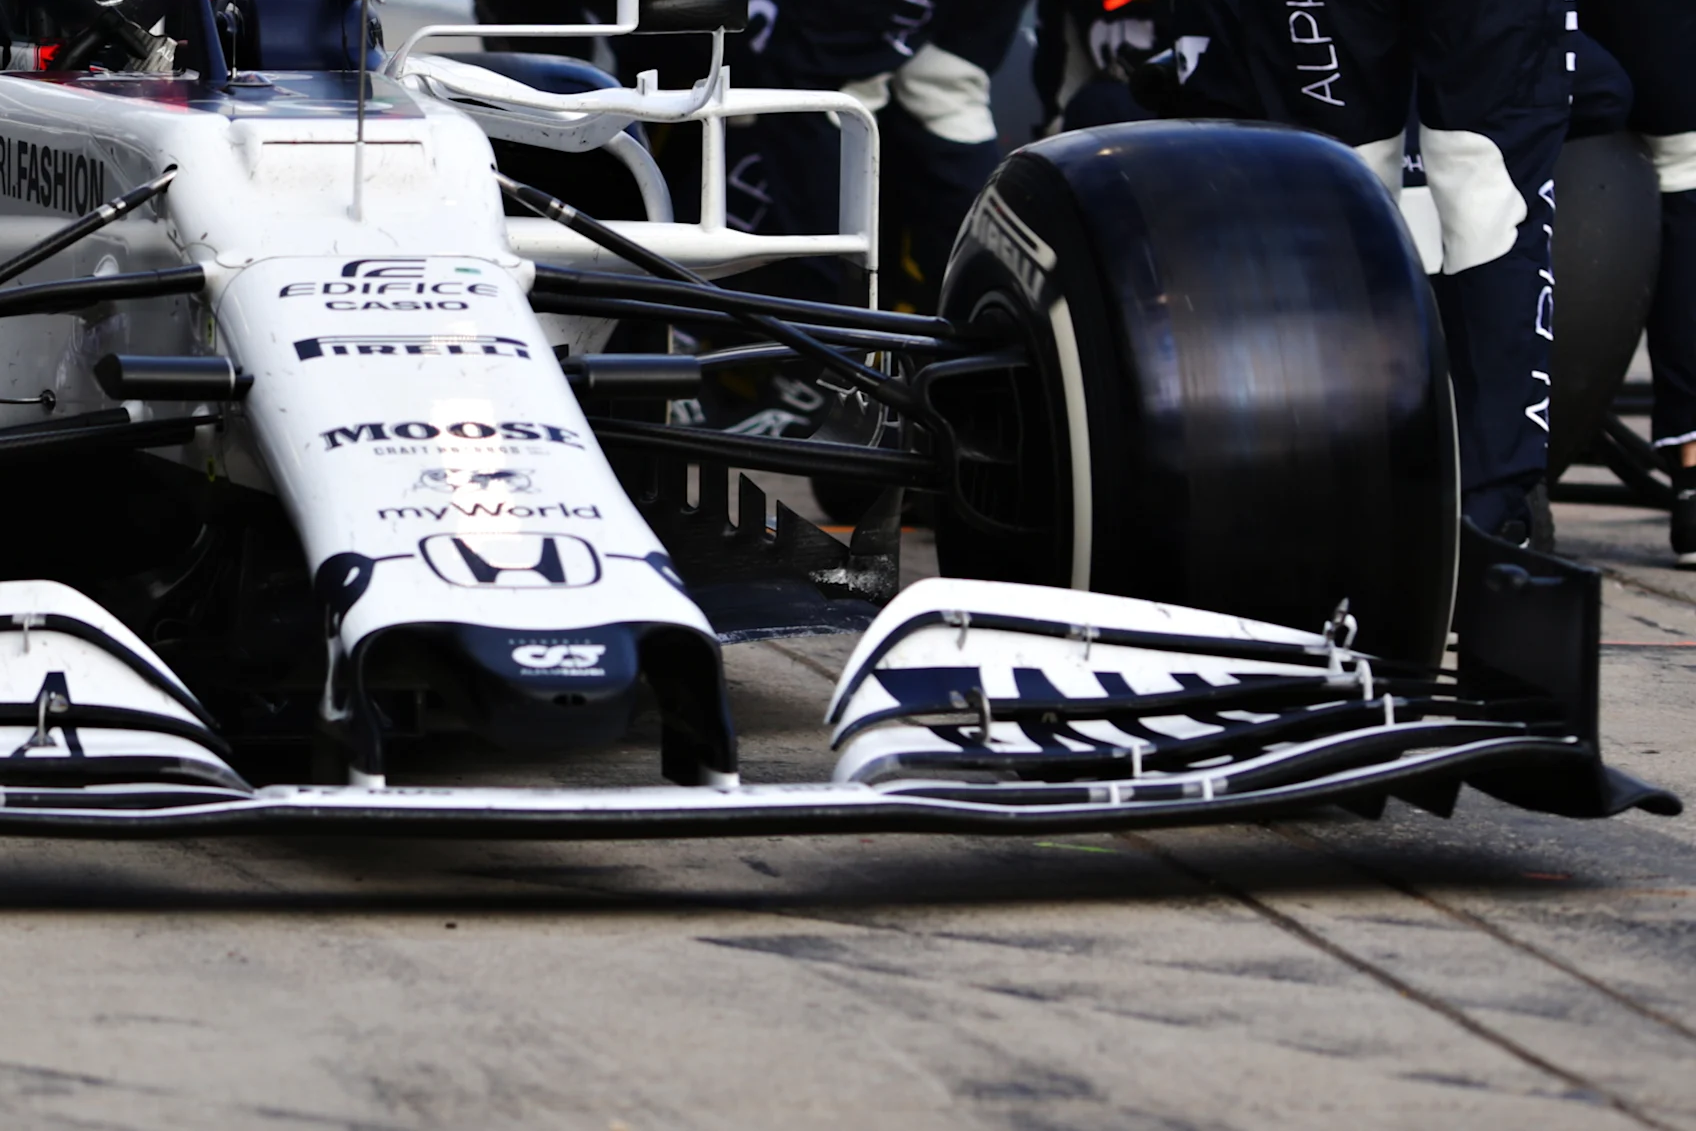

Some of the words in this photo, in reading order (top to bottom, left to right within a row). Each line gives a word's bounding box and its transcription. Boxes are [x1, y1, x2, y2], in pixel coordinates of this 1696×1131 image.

[279, 282, 498, 298] EDIFICE
[325, 301, 469, 311] CASIO
[293, 335, 532, 362] PIRELLI
[319, 421, 586, 451] MOOSE
[377, 501, 603, 521] myWorld
